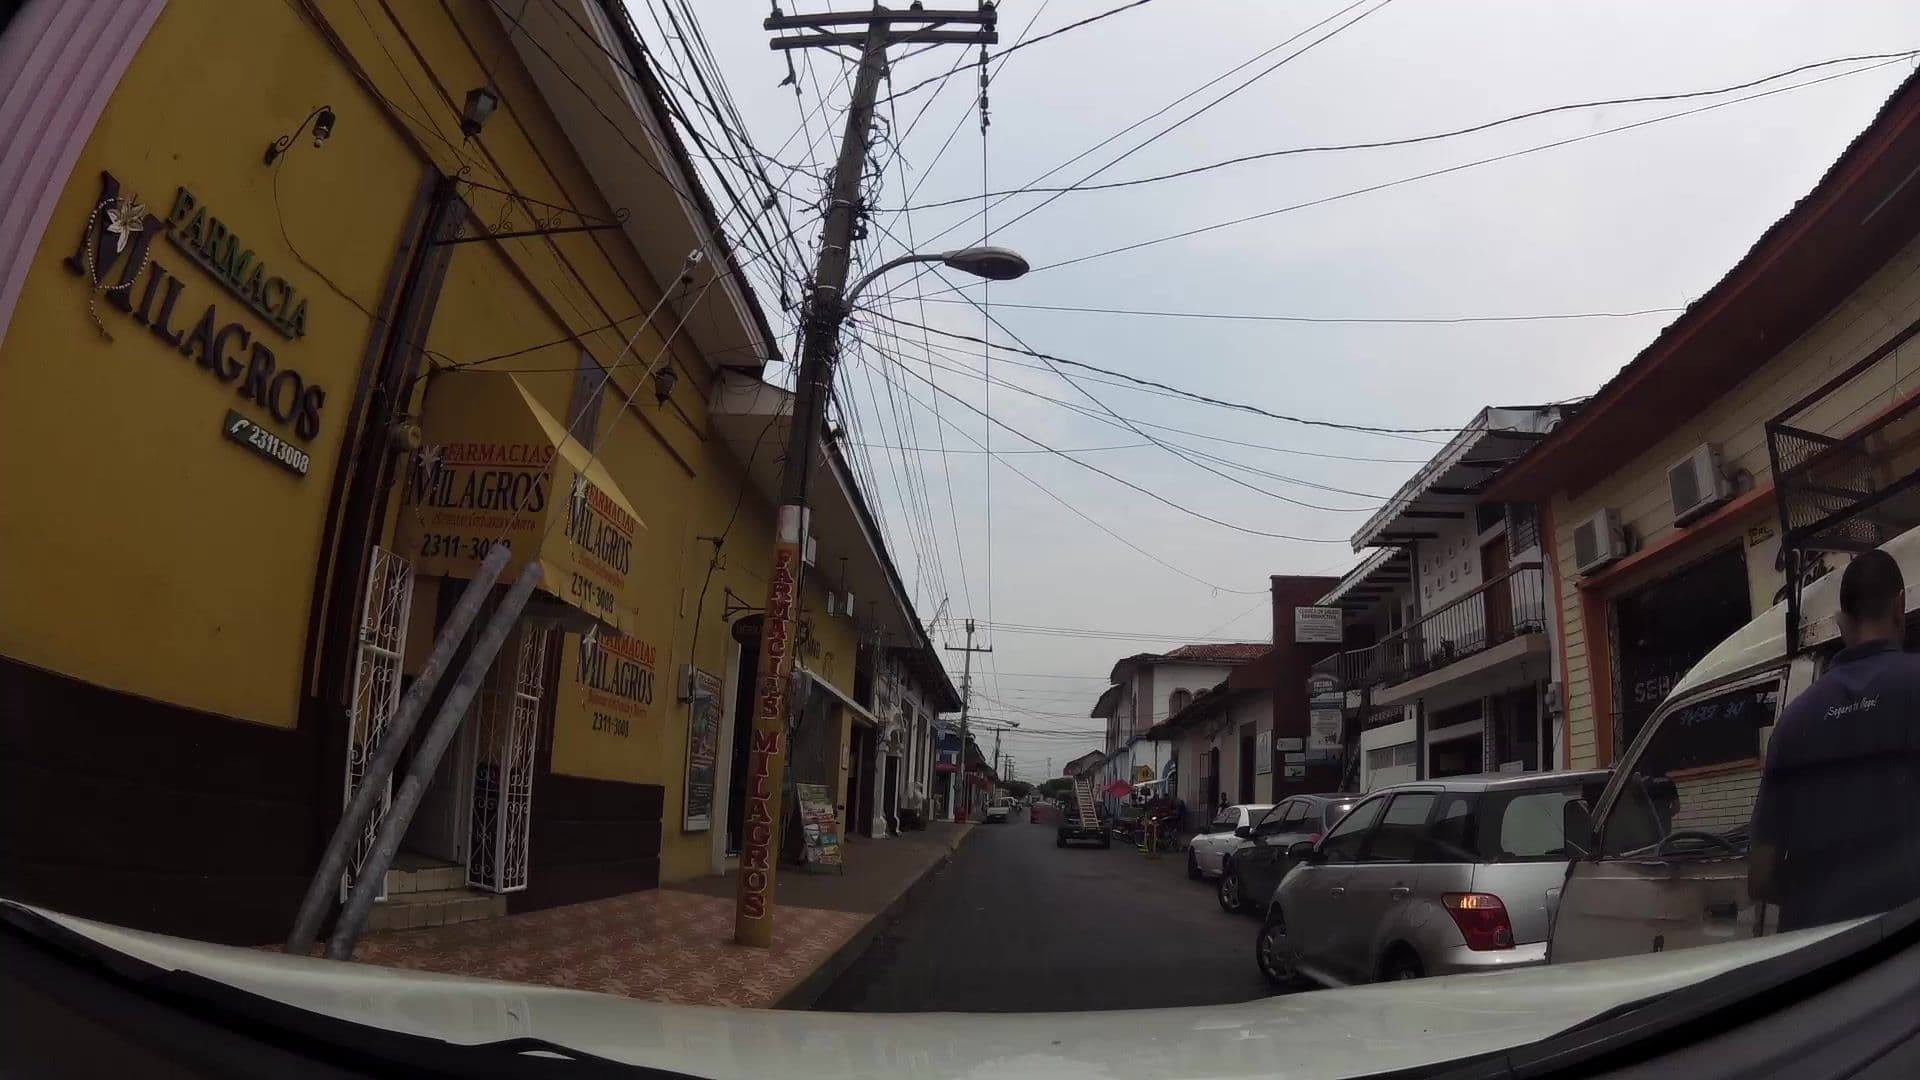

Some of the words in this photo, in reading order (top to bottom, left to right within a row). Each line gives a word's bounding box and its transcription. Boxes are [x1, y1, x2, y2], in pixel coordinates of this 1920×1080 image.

[167, 186, 310, 338] FARMACIA
[64, 170, 326, 440] MILAGROS
[248, 424, 310, 474] 23113008
[405, 447, 550, 512] MILAGROS
[447, 442, 555, 464] FARMACIAS
[565, 474, 632, 575] MILAGROS
[588, 485, 635, 533] FARMACIAS
[571, 572, 614, 614] 2311-3008
[576, 633, 655, 704] MILAGROS
[761, 549, 795, 720] FARMACIAS
[743, 729, 780, 921] MILAGROS
